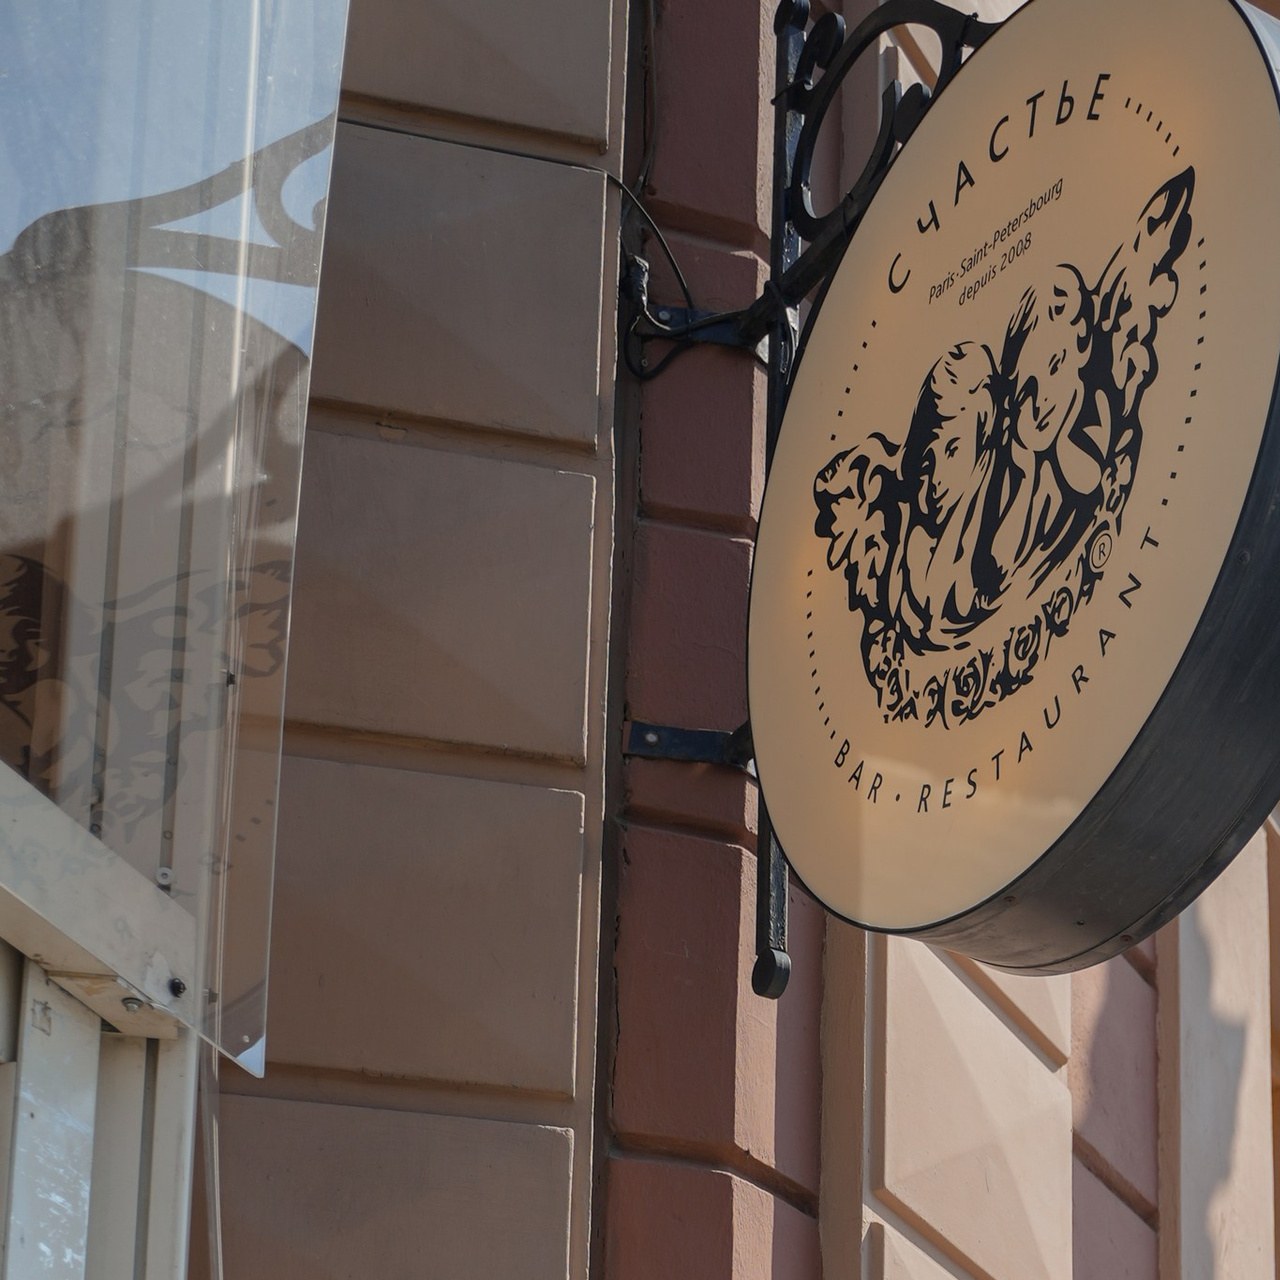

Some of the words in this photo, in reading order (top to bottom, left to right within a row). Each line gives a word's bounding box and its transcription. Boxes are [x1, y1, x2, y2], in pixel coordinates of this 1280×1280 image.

[888, 73, 1111, 294] СЧАСТЬЕ
[958, 264, 997, 306] depuis
[1000, 232, 1032, 272] 2008
[834, 739, 883, 804] BAR
[917, 526, 1160, 813] RESTAURANT
